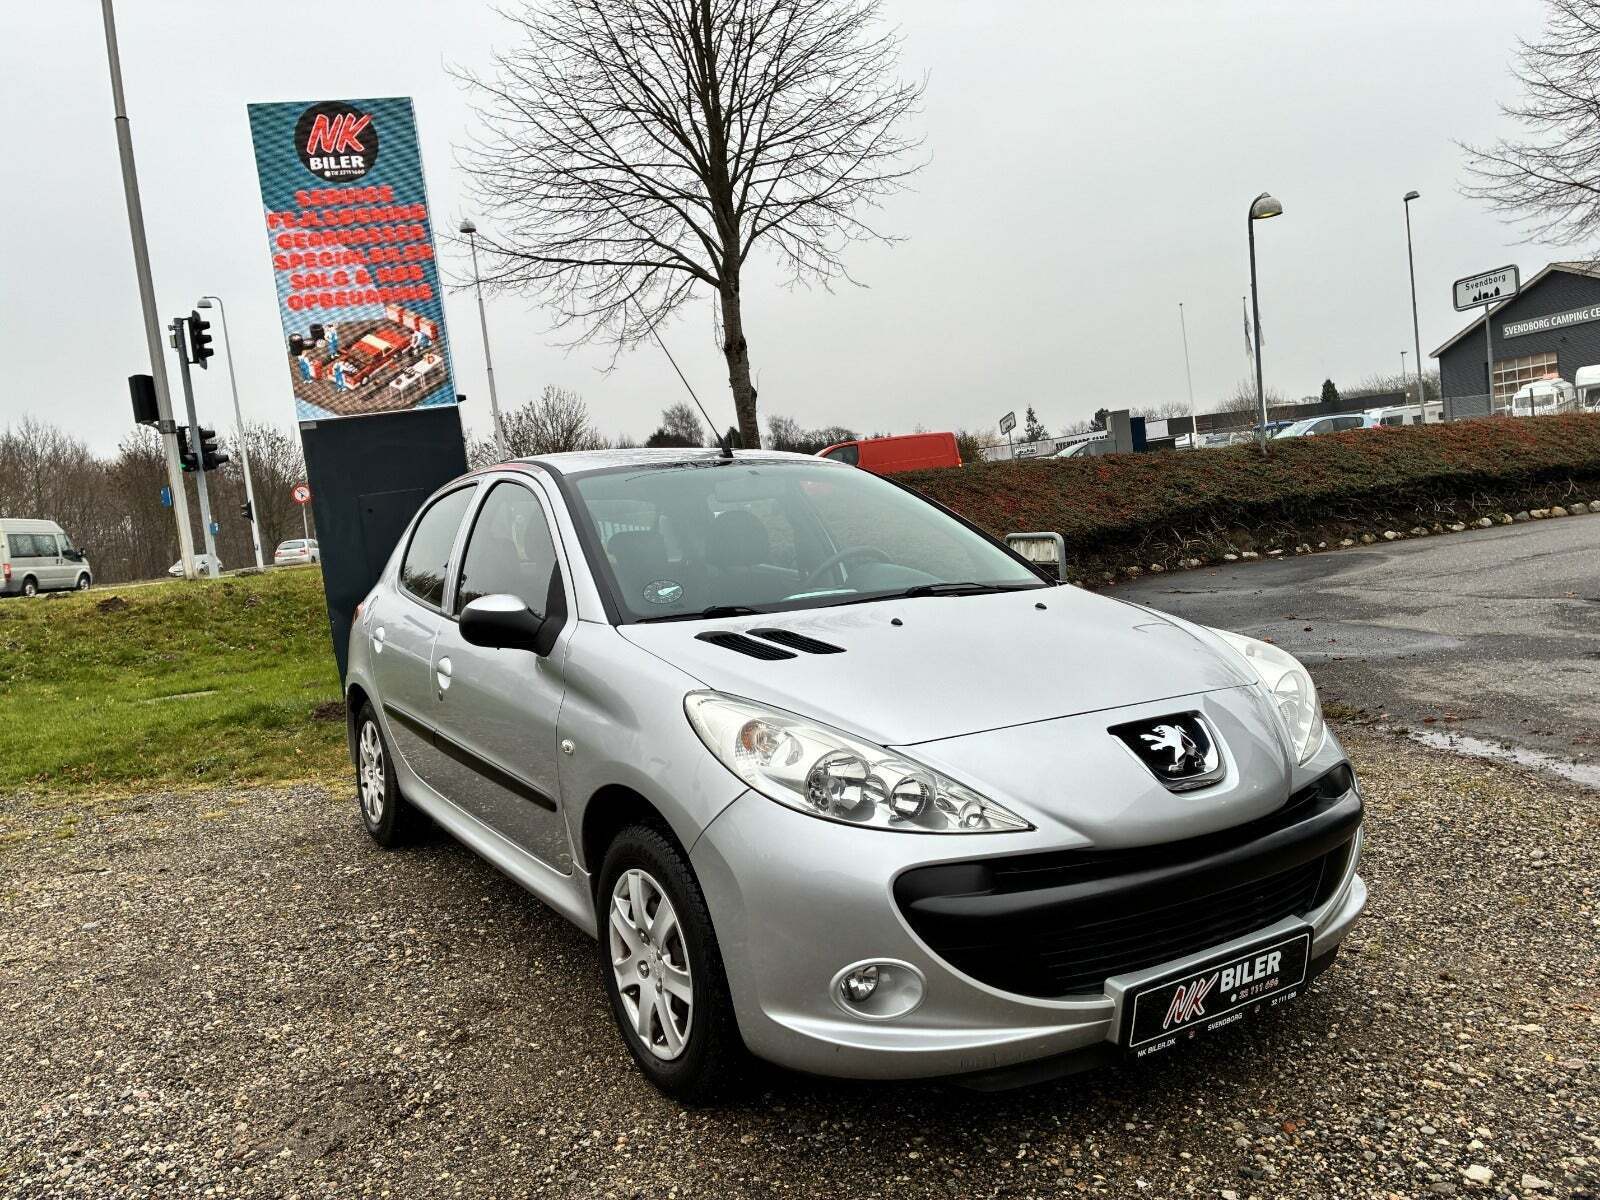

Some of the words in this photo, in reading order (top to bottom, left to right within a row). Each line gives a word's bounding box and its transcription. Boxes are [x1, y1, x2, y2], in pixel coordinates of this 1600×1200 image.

[306, 113, 373, 155] NK
[309, 155, 365, 171] BILER
[289, 269, 350, 290] SALG
[1465, 274, 1506, 291] Svendborg
[1504, 318, 1550, 336] SVENDBORG
[1551, 310, 1589, 326] CAMPING
[1162, 971, 1220, 1029] NK
[1219, 950, 1282, 993] BILER
[1207, 1012, 1243, 1031] SVENDBORG
[1137, 1048, 1147, 1058] NK
